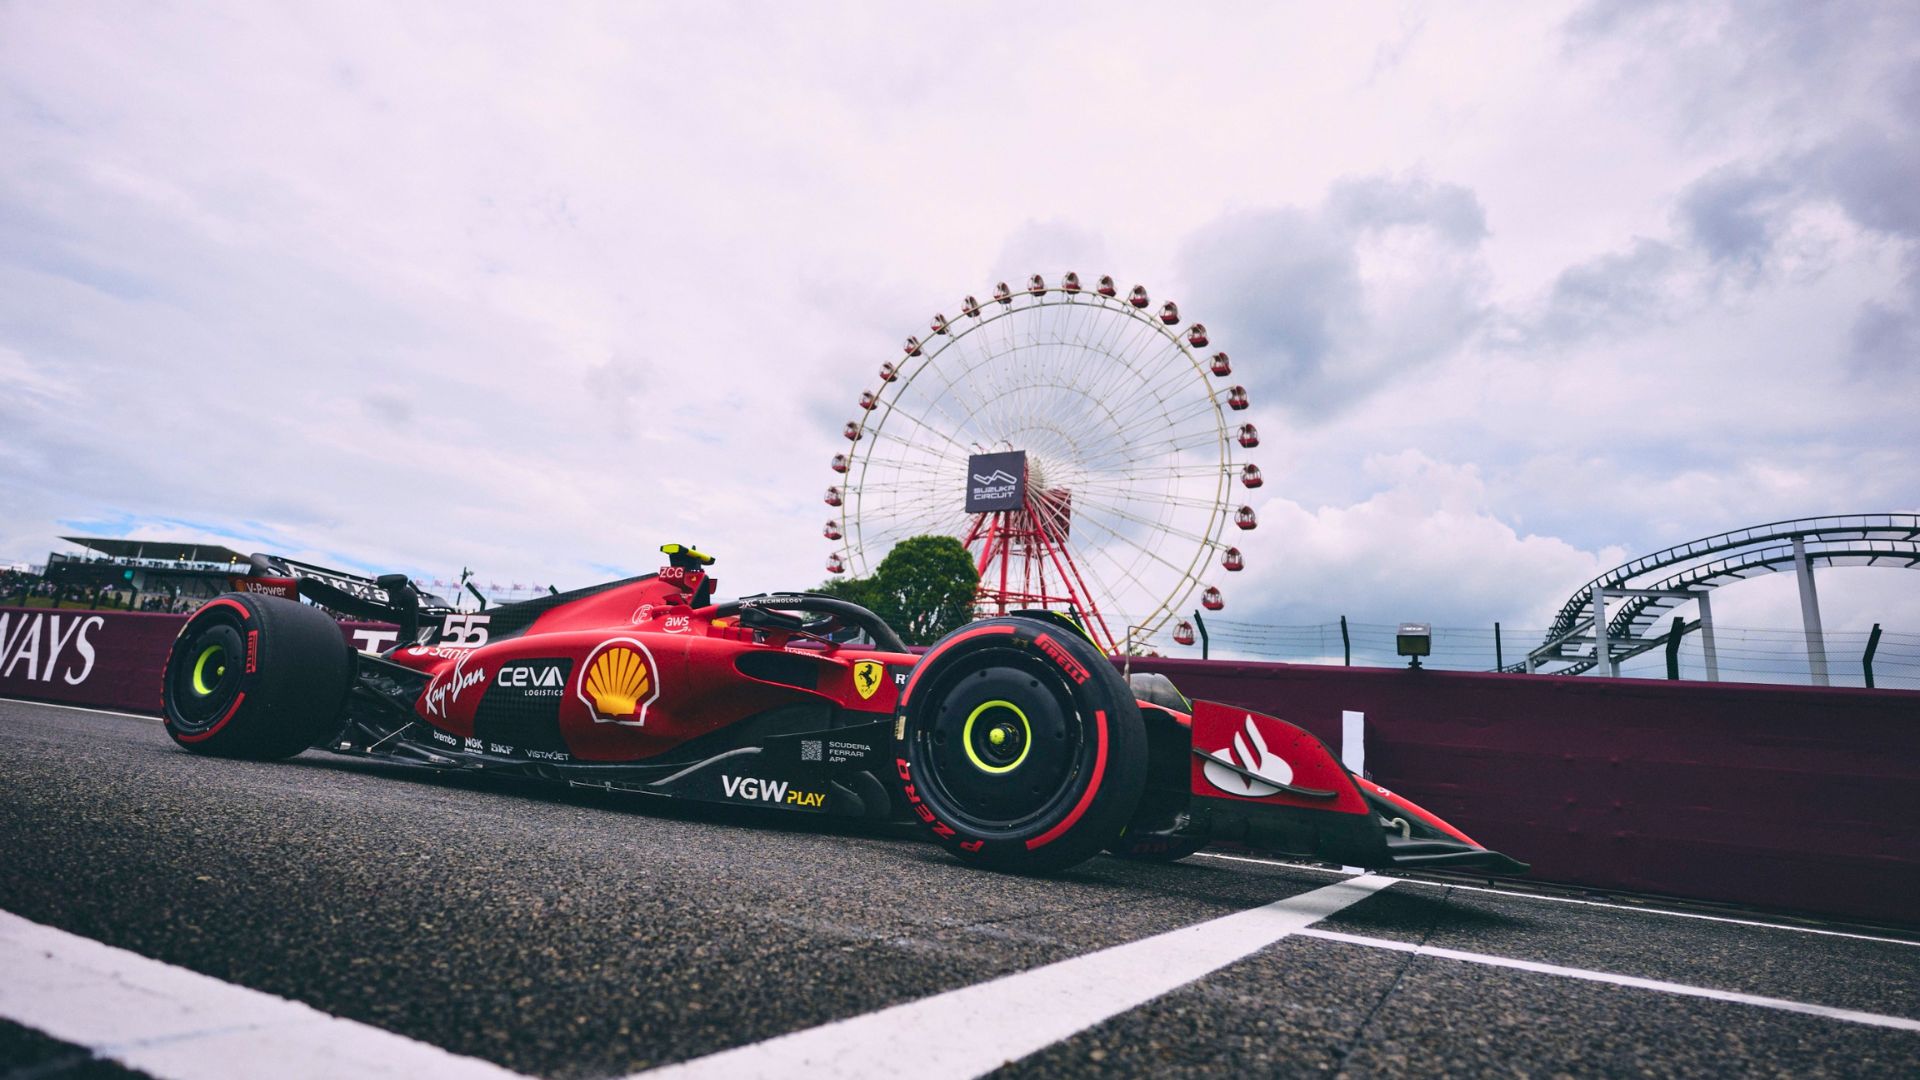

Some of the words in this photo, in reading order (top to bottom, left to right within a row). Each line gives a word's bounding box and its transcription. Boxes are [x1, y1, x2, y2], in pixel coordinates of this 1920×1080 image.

[973, 484, 1016, 494] SUZUKA
[973, 491, 1014, 500] CIRCUIT
[659, 567, 684, 579] ZCG
[246, 582, 286, 596] V-Power
[665, 616, 690, 627] aws
[438, 614, 491, 648] 55
[895, 673, 909, 684] R
[524, 689, 565, 697] LOGISTICS
[433, 730, 457, 746] brembo
[464, 737, 483, 750] NGK
[490, 742, 514, 755] SKF
[829, 741, 871, 751] SCUDERIA
[829, 749, 864, 757] FERRARI
[721, 774, 789, 803] VGW
[786, 790, 826, 807] PLAY
